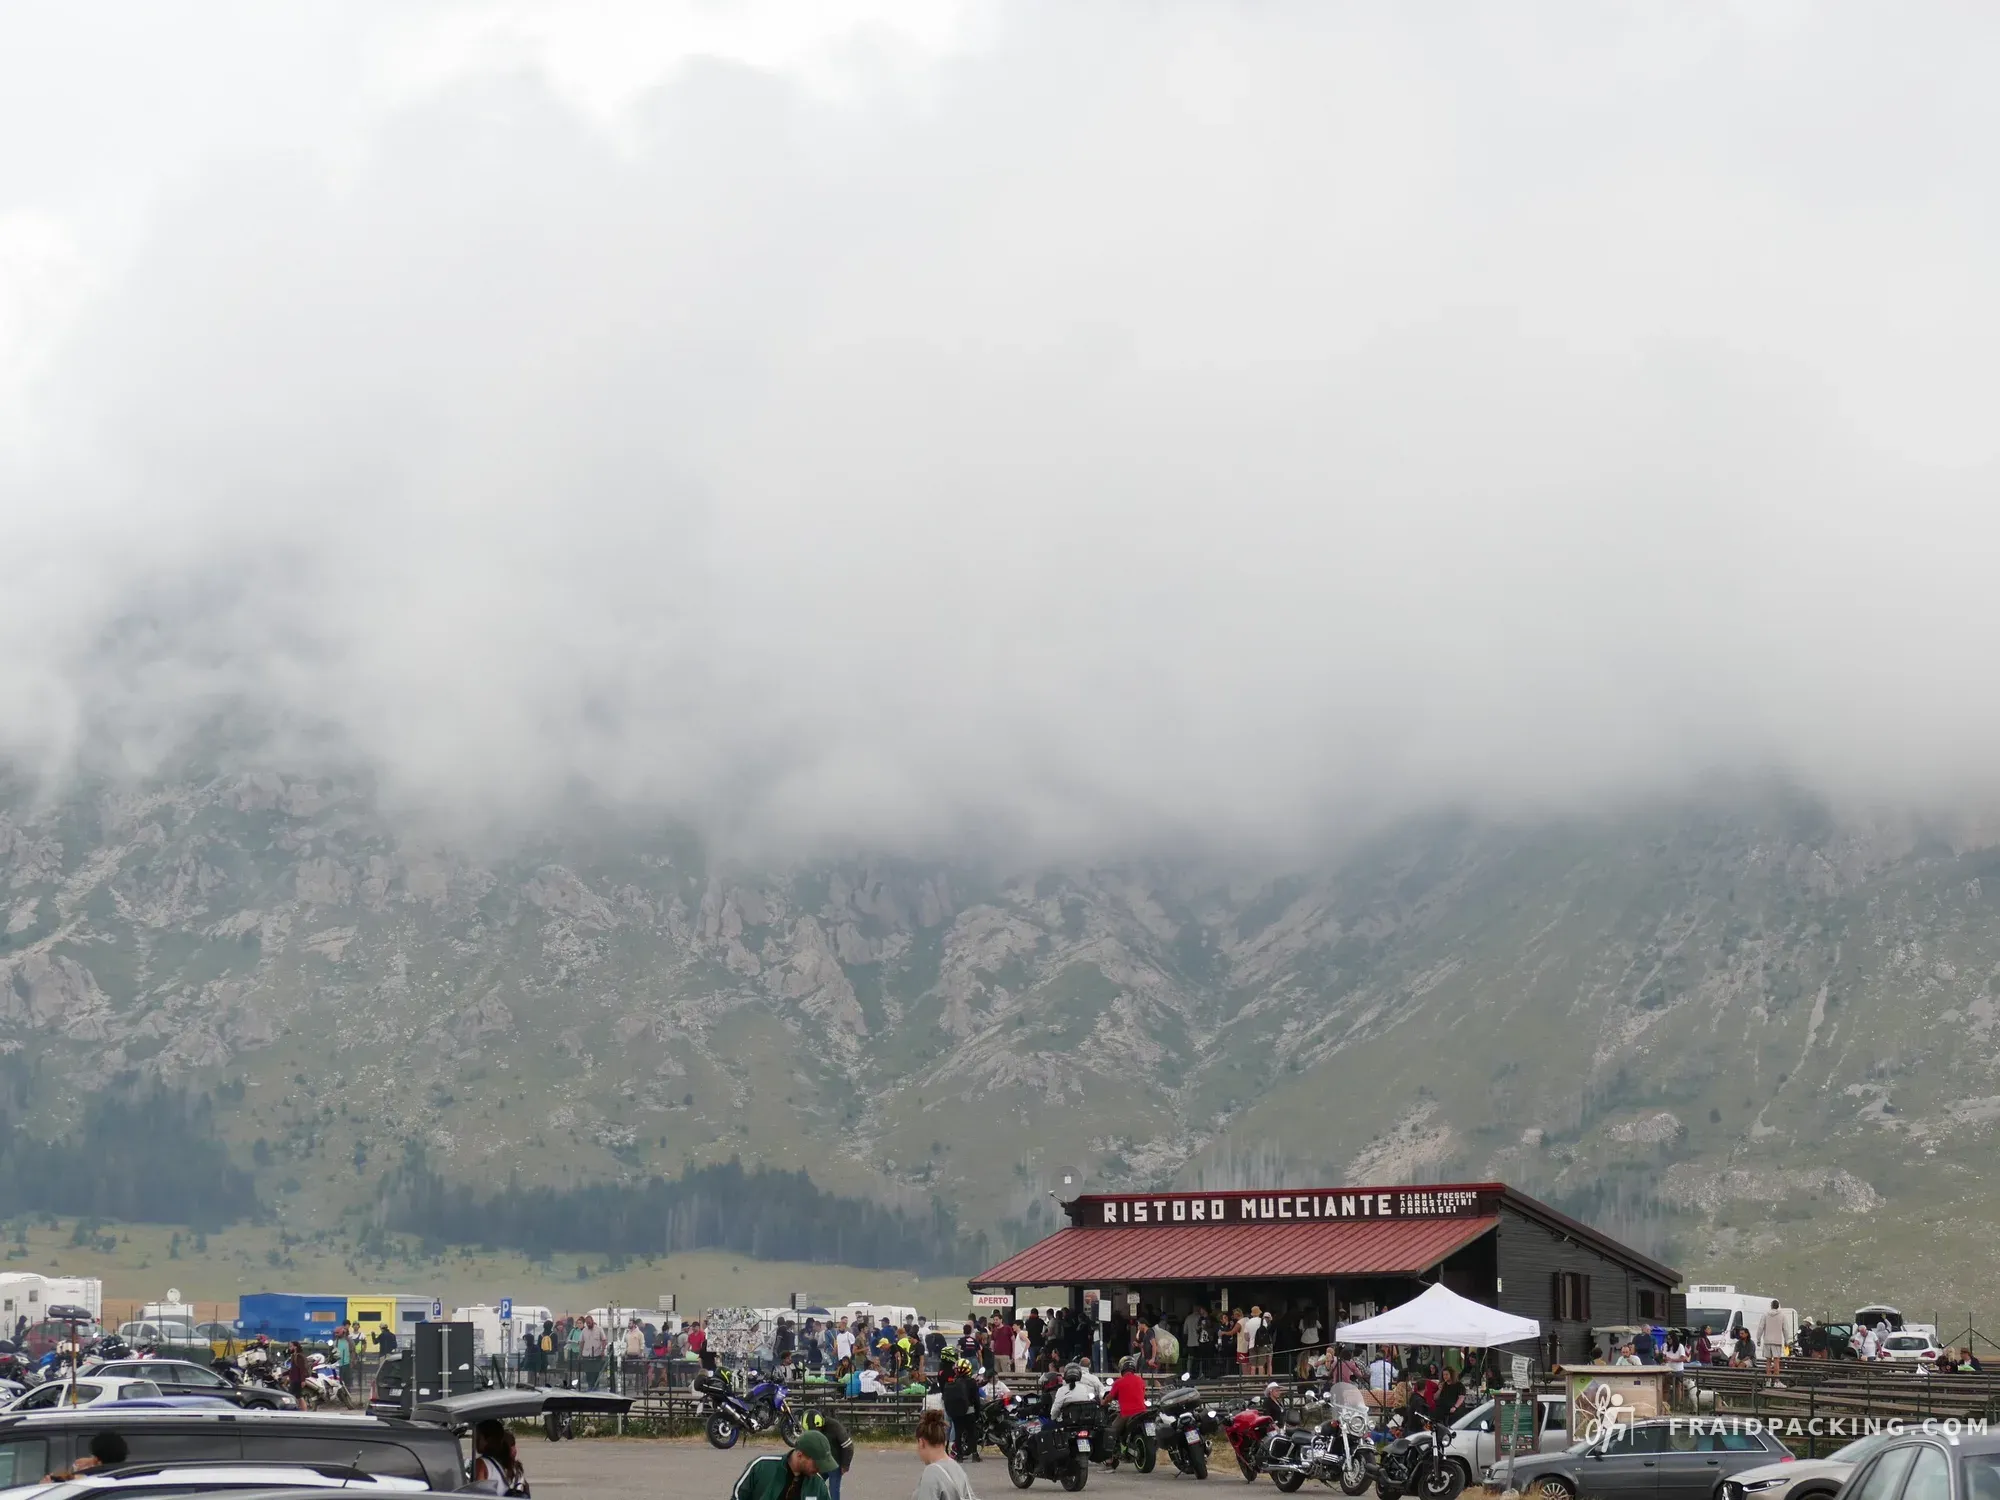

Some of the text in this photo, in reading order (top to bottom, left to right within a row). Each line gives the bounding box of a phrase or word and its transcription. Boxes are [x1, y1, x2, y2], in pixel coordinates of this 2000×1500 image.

[1103, 1194, 1392, 1222] RISTORO MUCCIANTE
[1400, 1199, 1472, 1207] ARROSTICINI
[1400, 1206, 1456, 1214] FORMAGGI
[434, 1304, 440, 1314] P
[502, 1301, 509, 1317] P
